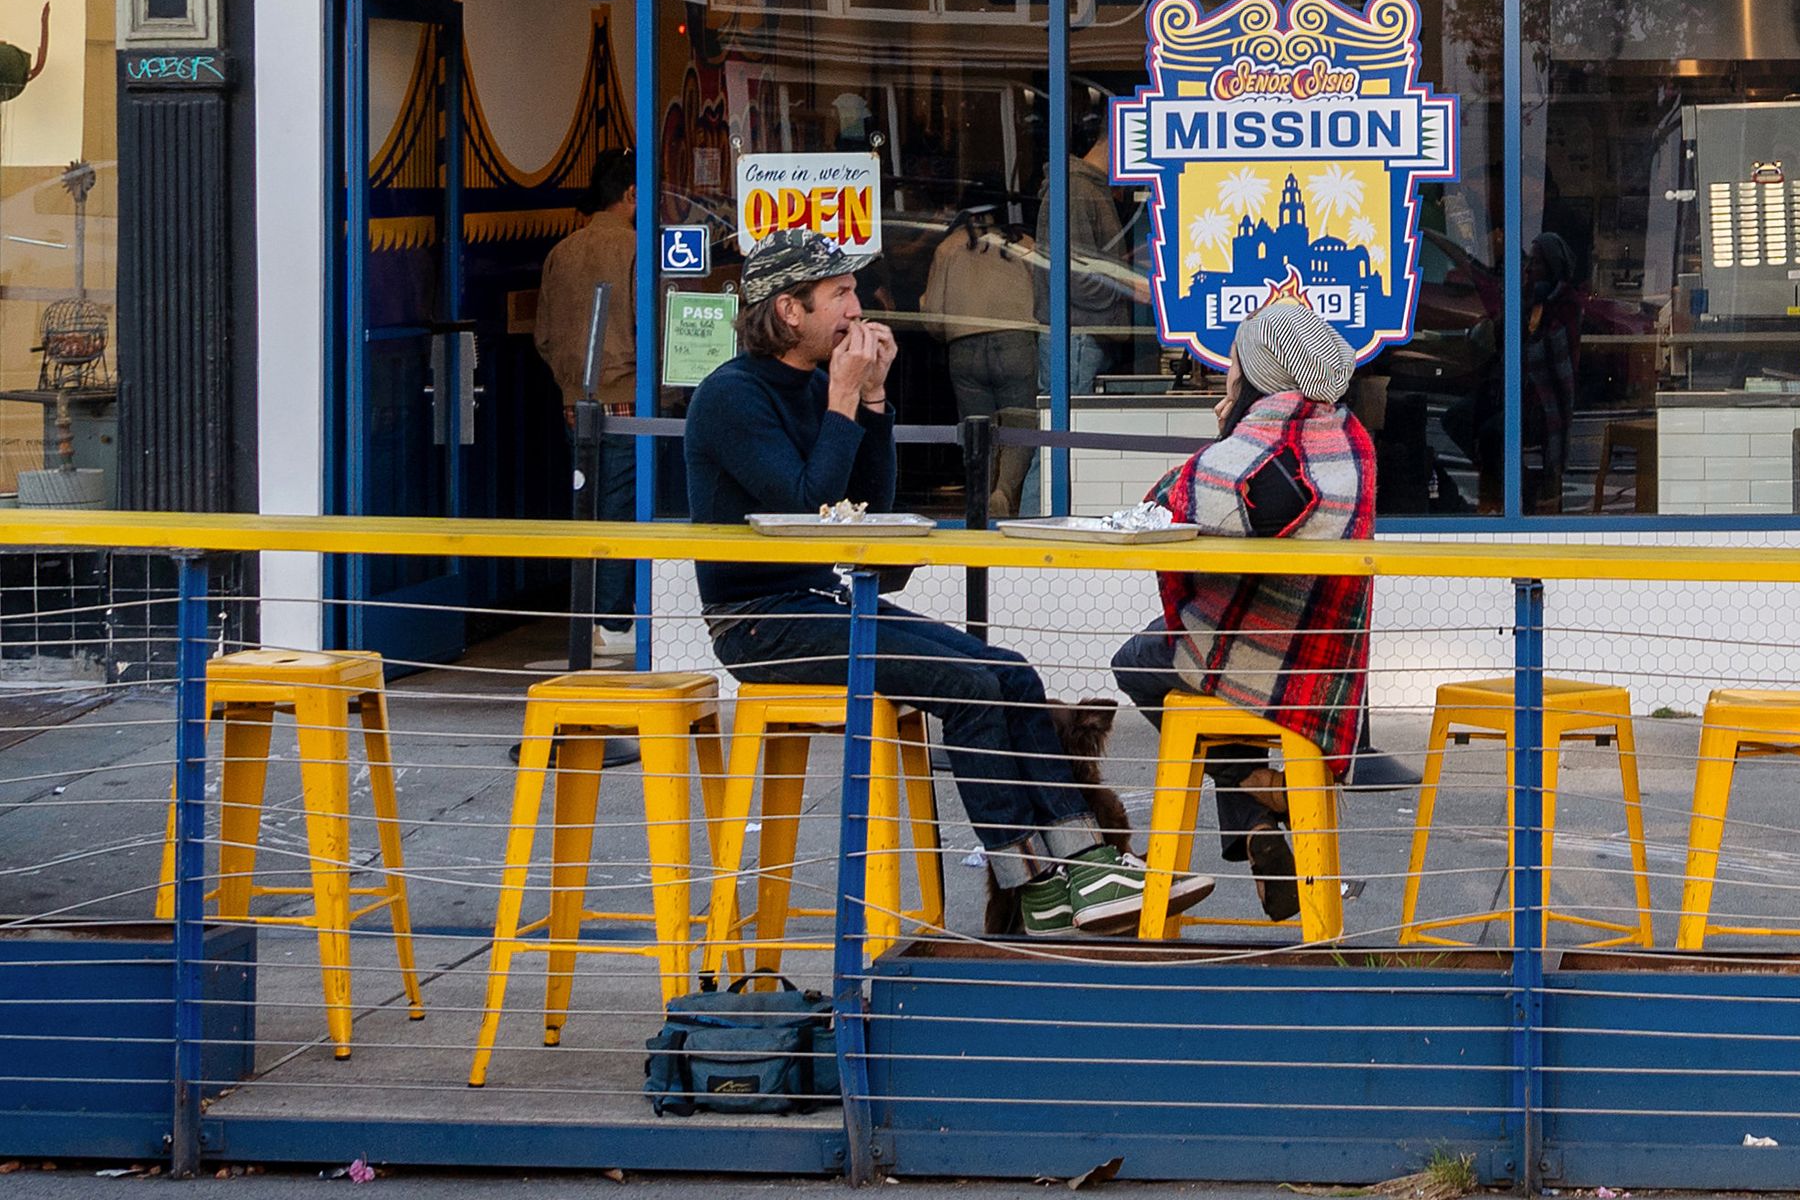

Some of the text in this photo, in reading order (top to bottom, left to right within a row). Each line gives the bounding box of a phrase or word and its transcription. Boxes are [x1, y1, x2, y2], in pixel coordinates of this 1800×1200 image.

[1165, 109, 1402, 150] MISSION
[745, 163, 787, 182] Come
[819, 165, 870, 181] we're
[744, 185, 873, 245] OPEN
[683, 306, 724, 320] PASS
[1228, 293, 1342, 315] 20 19
